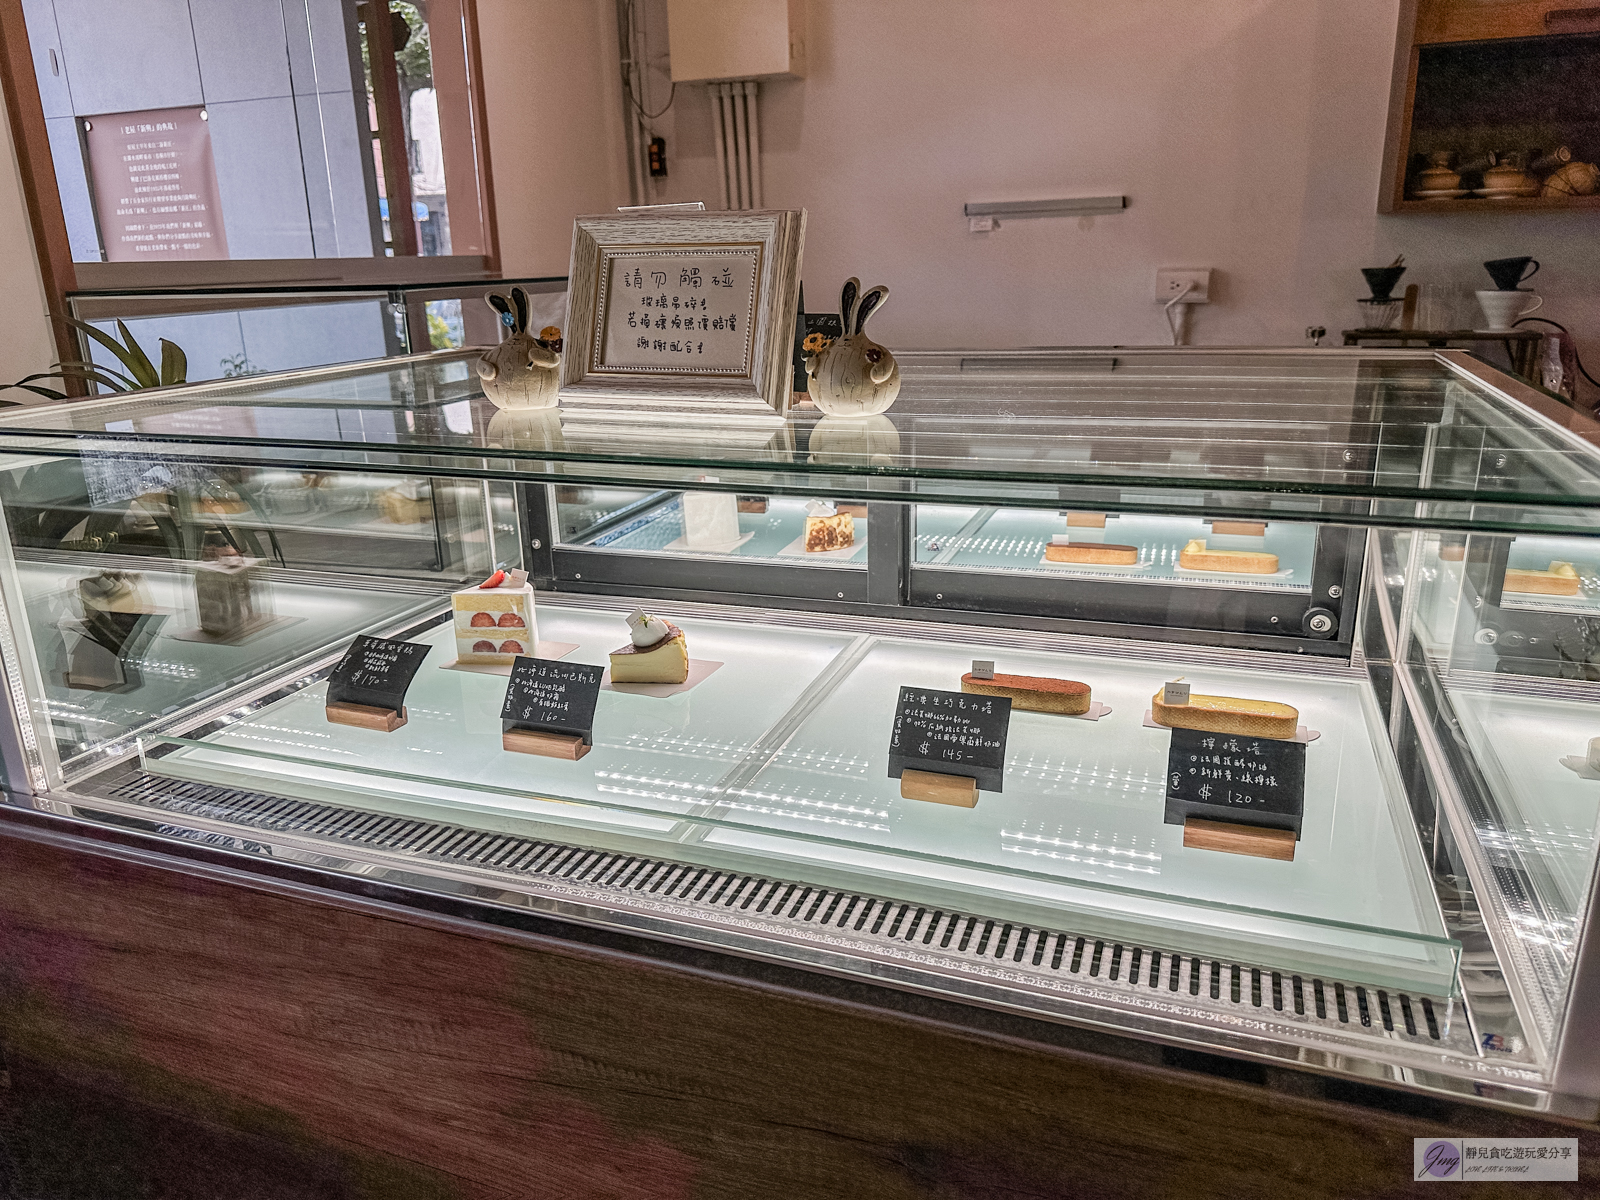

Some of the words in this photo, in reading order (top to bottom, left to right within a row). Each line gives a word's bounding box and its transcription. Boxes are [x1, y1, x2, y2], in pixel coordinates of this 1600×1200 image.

[624, 267, 734, 289] 請勿觸碰
[1202, 737, 1260, 755] 檸檬塔
